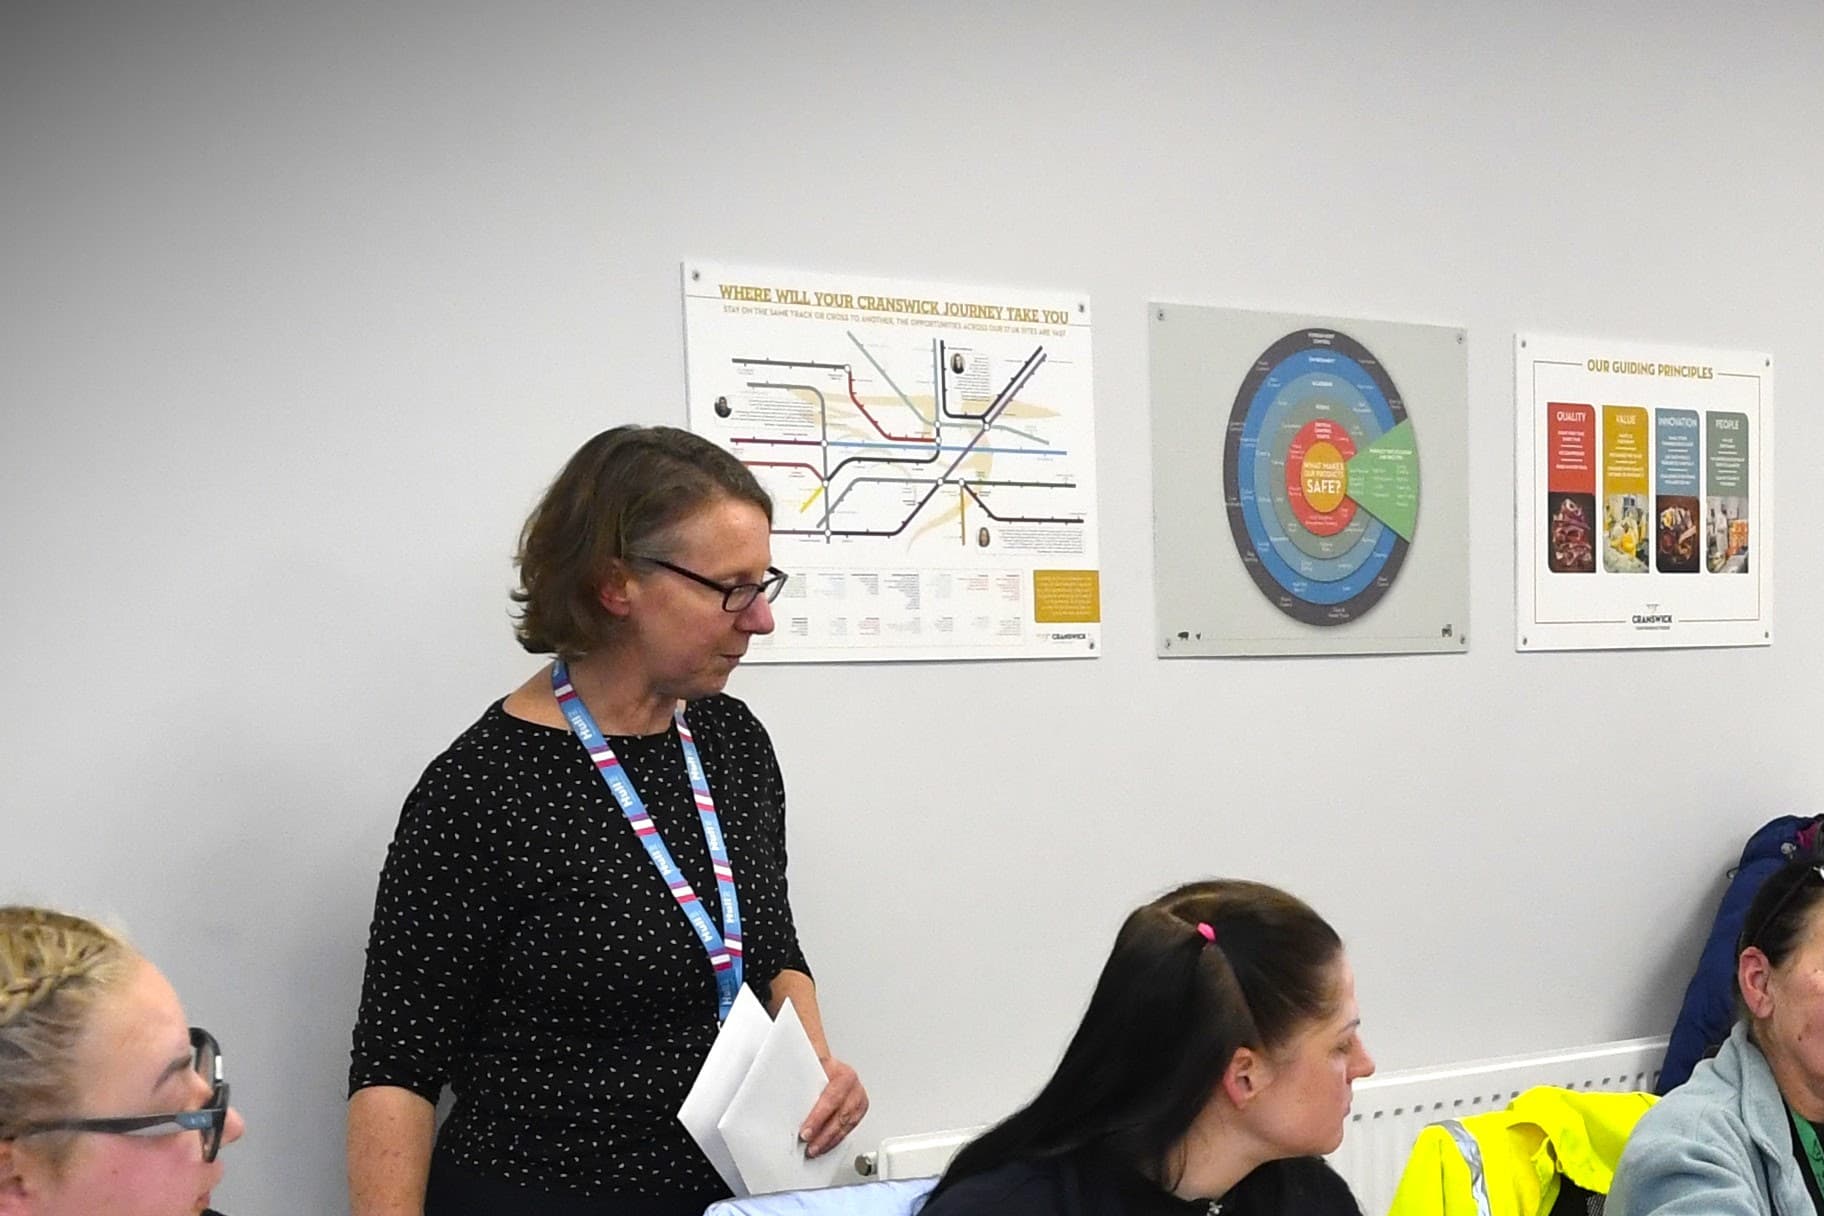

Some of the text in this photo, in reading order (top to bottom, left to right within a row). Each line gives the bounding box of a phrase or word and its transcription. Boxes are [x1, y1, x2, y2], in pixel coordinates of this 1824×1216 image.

[719, 284, 1069, 325] WHERE WILL YOUR CRANSWICK JOURNEY TAKE YOU
[1587, 359, 1713, 380] OUR GUIDING PRINCIPLES
[1556, 410, 1587, 423] QUALITY
[1615, 414, 1636, 426] VALUE
[1658, 416, 1698, 428] INNOVATION
[1715, 419, 1739, 431] PEOPLE
[1307, 479, 1342, 494] SAFE?
[1632, 614, 1673, 624] CRANSWICK
[571, 714, 593, 740] Hull
[612, 781, 634, 808] Hull
[652, 850, 672, 876] Hull
[693, 916, 714, 942] Hull
